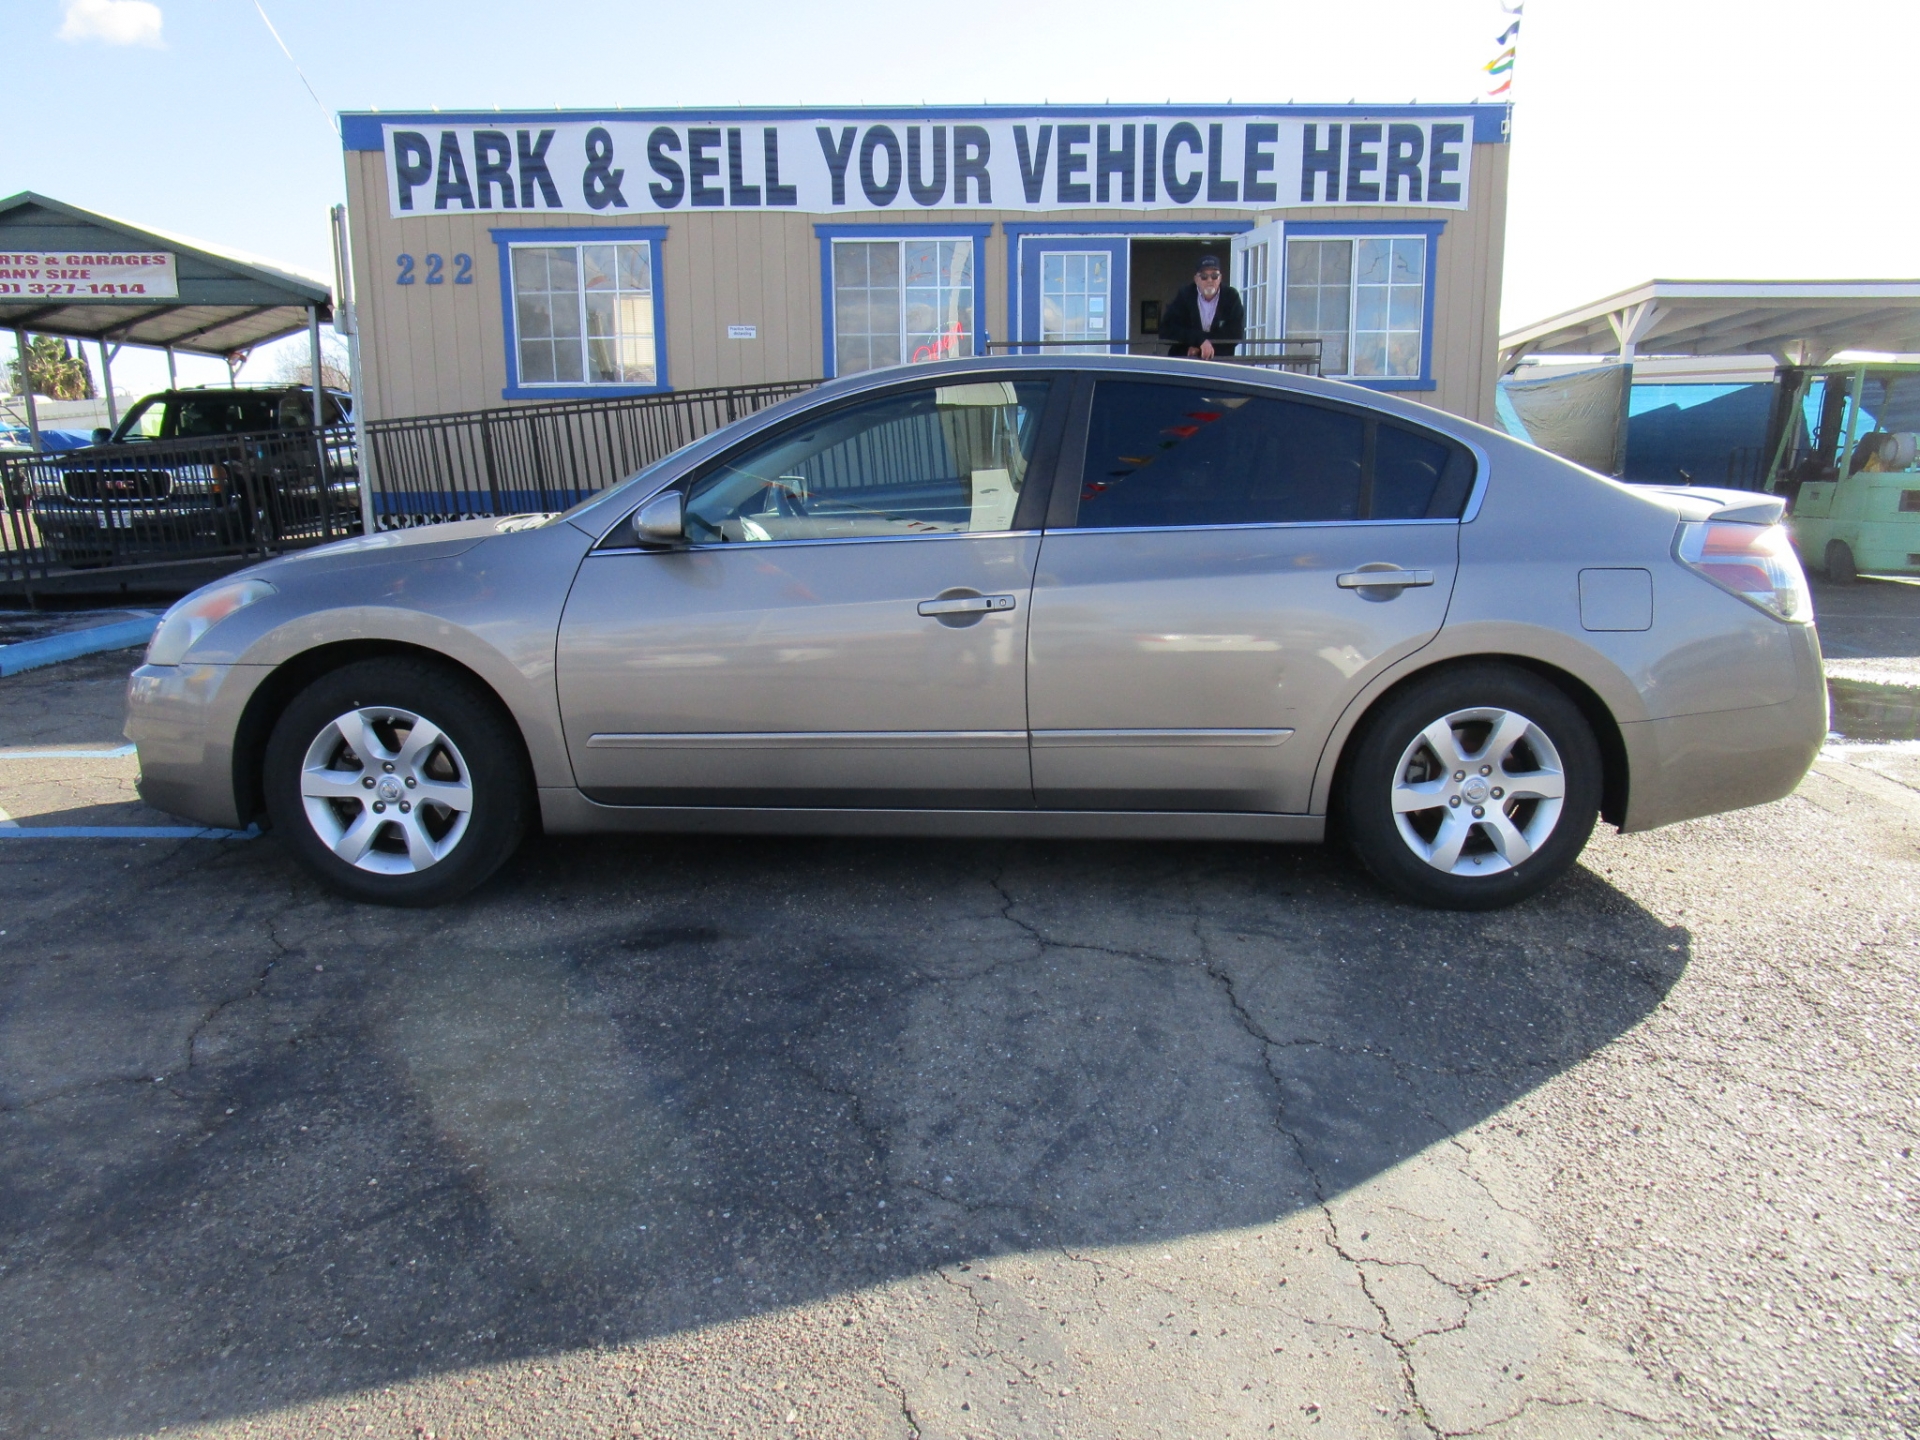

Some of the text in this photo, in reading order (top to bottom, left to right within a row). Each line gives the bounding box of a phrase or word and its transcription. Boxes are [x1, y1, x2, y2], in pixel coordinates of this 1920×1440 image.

[391, 121, 1464, 210] PARK & SELL YOUR VEHICLE HERE
[44, 257, 60, 265] &
[66, 255, 166, 265] GARAGES
[0, 269, 91, 279] ANY SIZE
[396, 253, 473, 285] 222
[28, 283, 147, 294] 327-1414
